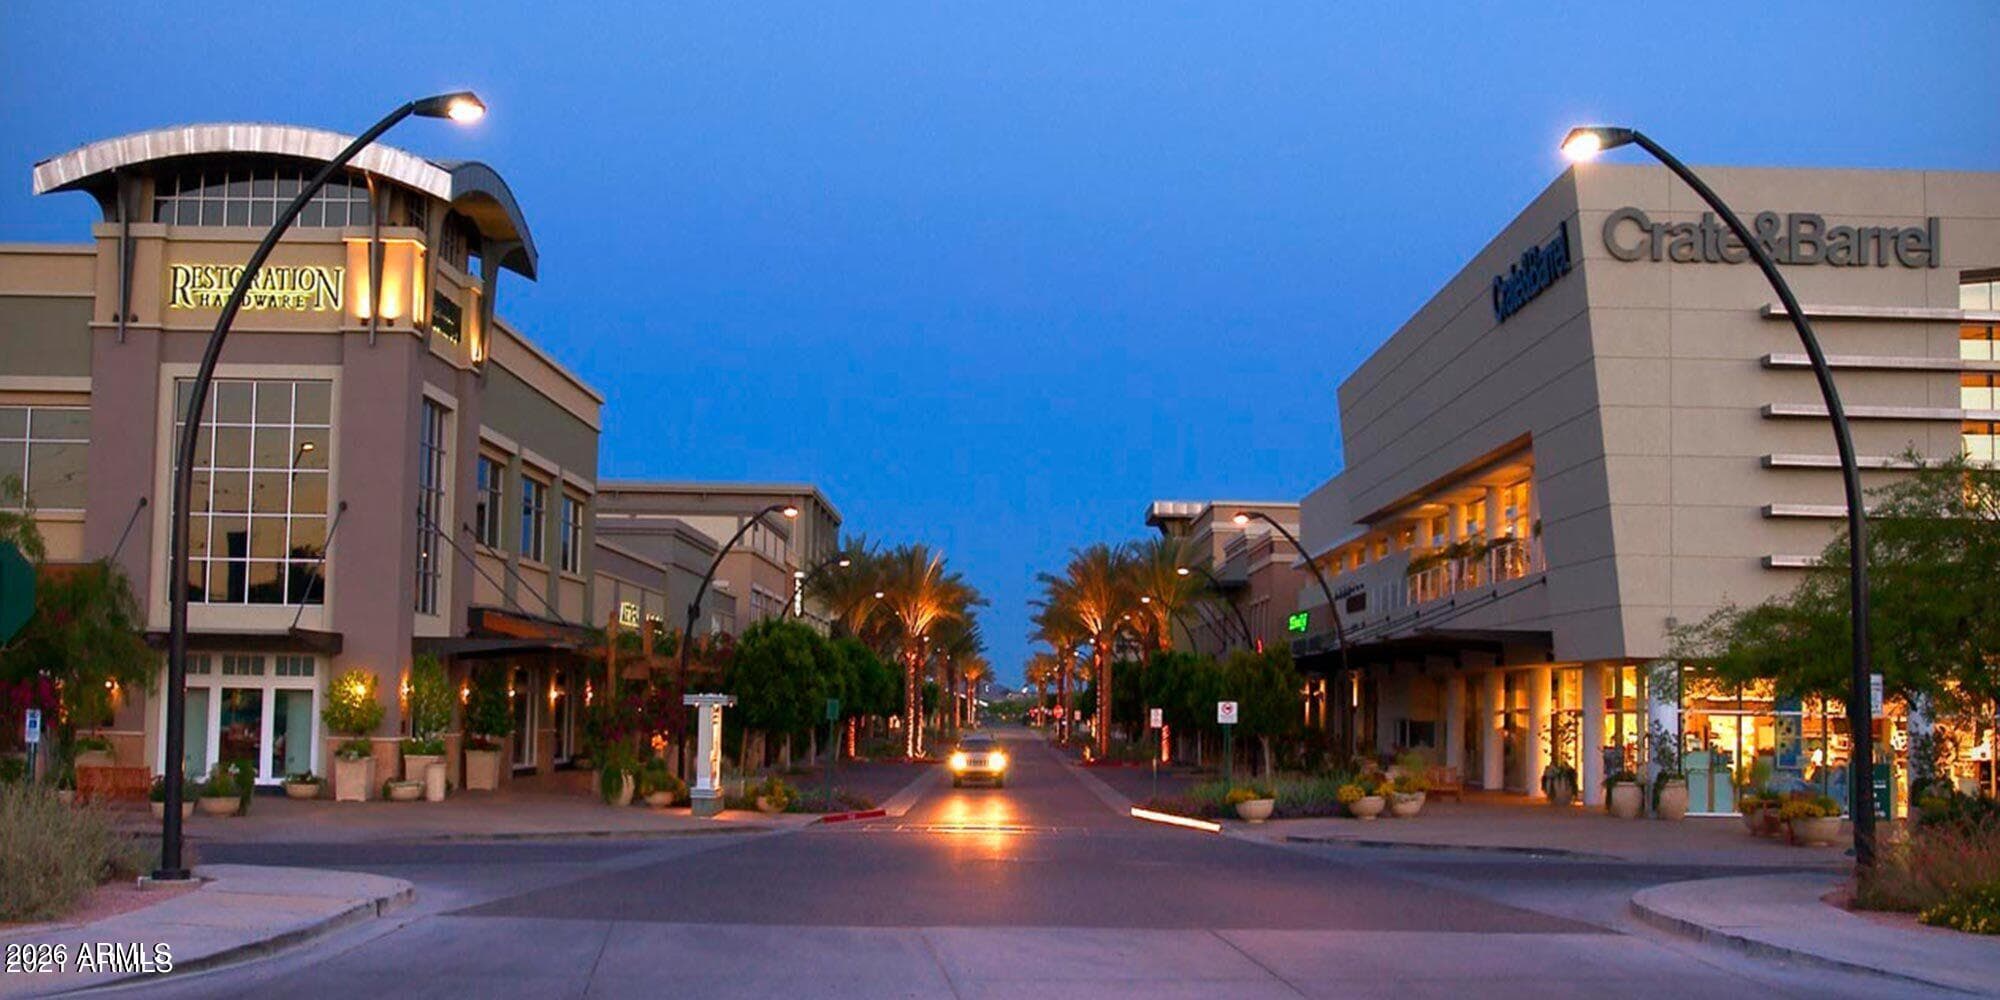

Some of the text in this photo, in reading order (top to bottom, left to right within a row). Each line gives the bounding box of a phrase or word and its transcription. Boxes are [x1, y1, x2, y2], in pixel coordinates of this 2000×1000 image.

[1602, 206, 1940, 268] Crate&Barrel
[199, 292, 306, 308] HADWARE
[1493, 221, 1572, 323] Crate&Barrel
